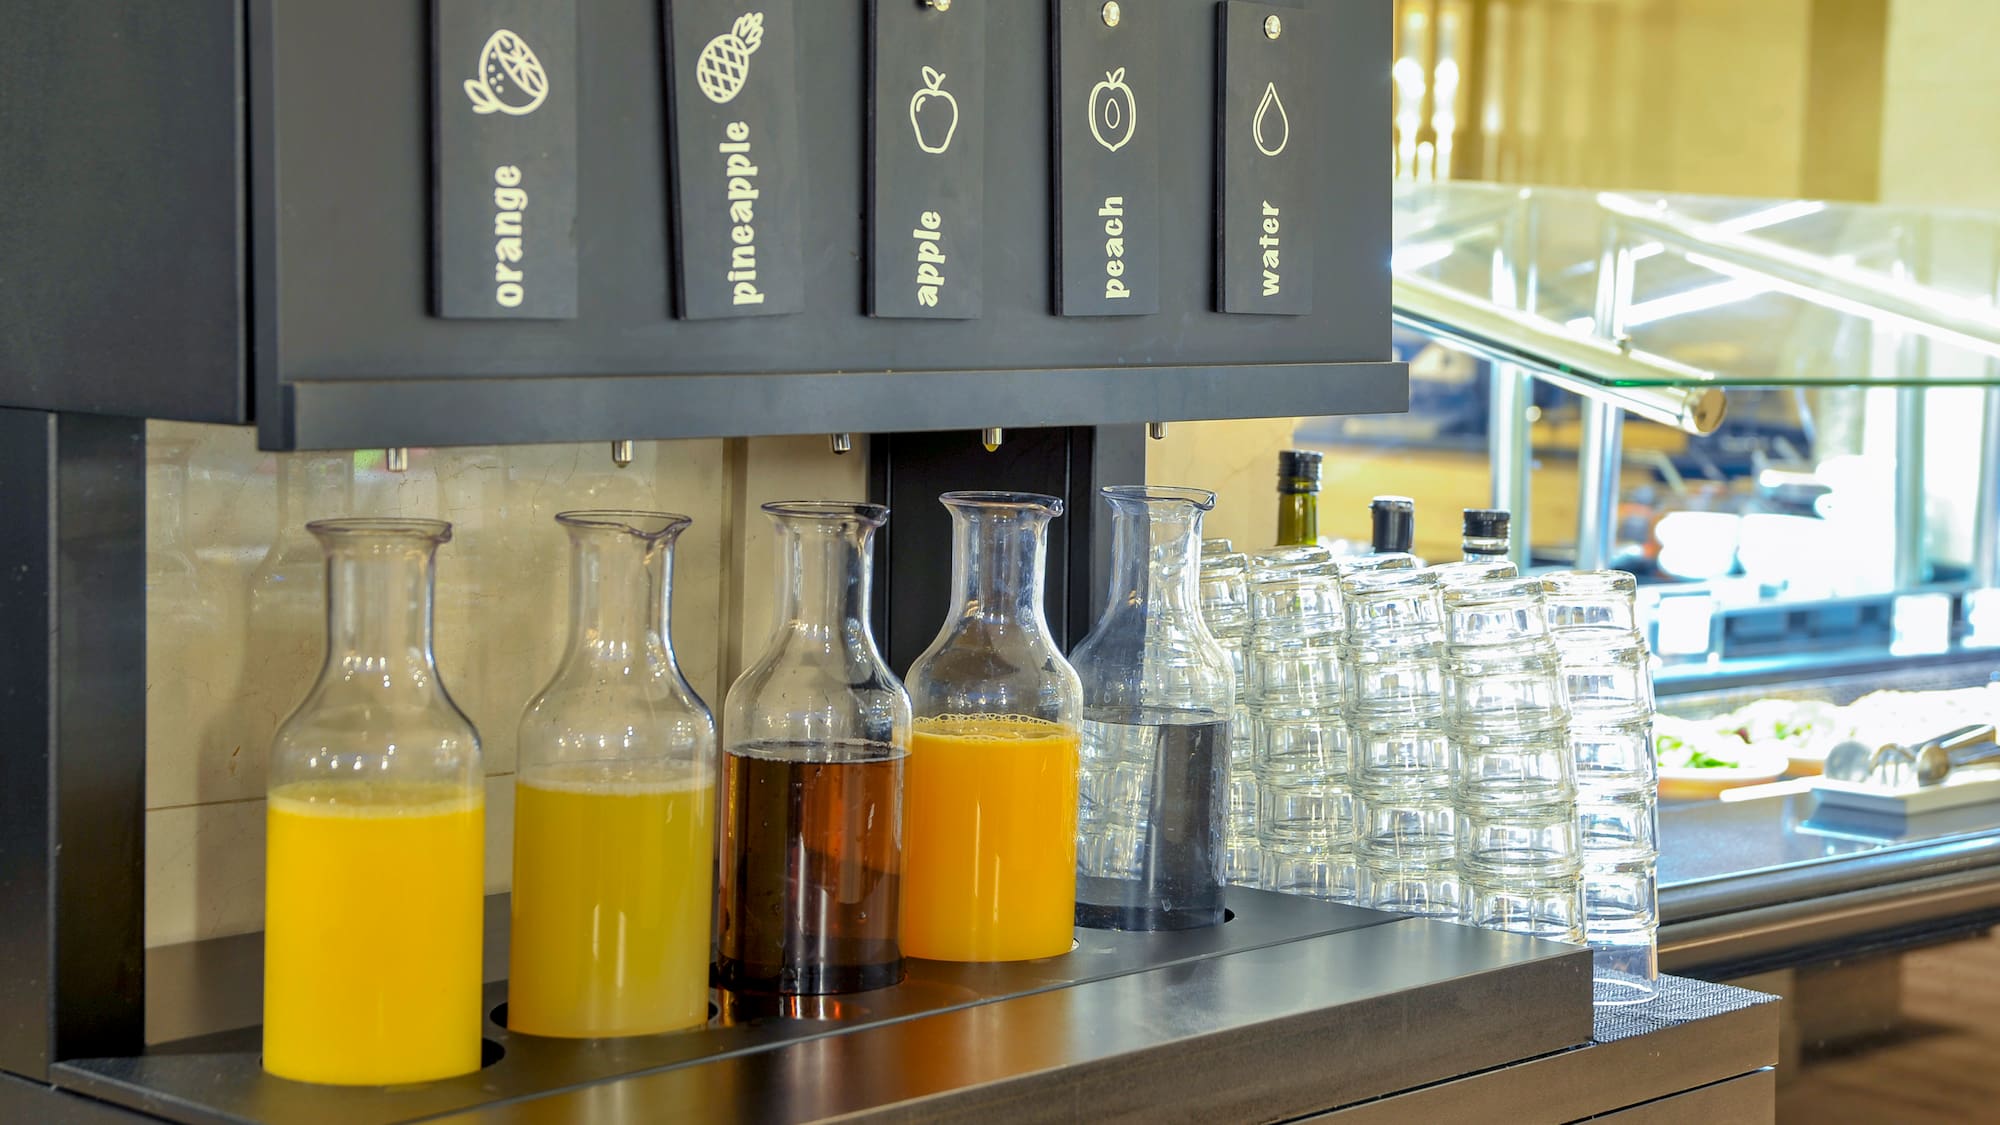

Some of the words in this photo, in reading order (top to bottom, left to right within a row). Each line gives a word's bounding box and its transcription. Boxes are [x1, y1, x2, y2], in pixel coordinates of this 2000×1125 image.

[494, 165, 528, 308] orange
[718, 121, 765, 306] pineapple
[913, 211, 945, 307] apple
[1099, 196, 1131, 299] peach
[1259, 199, 1280, 297] water
